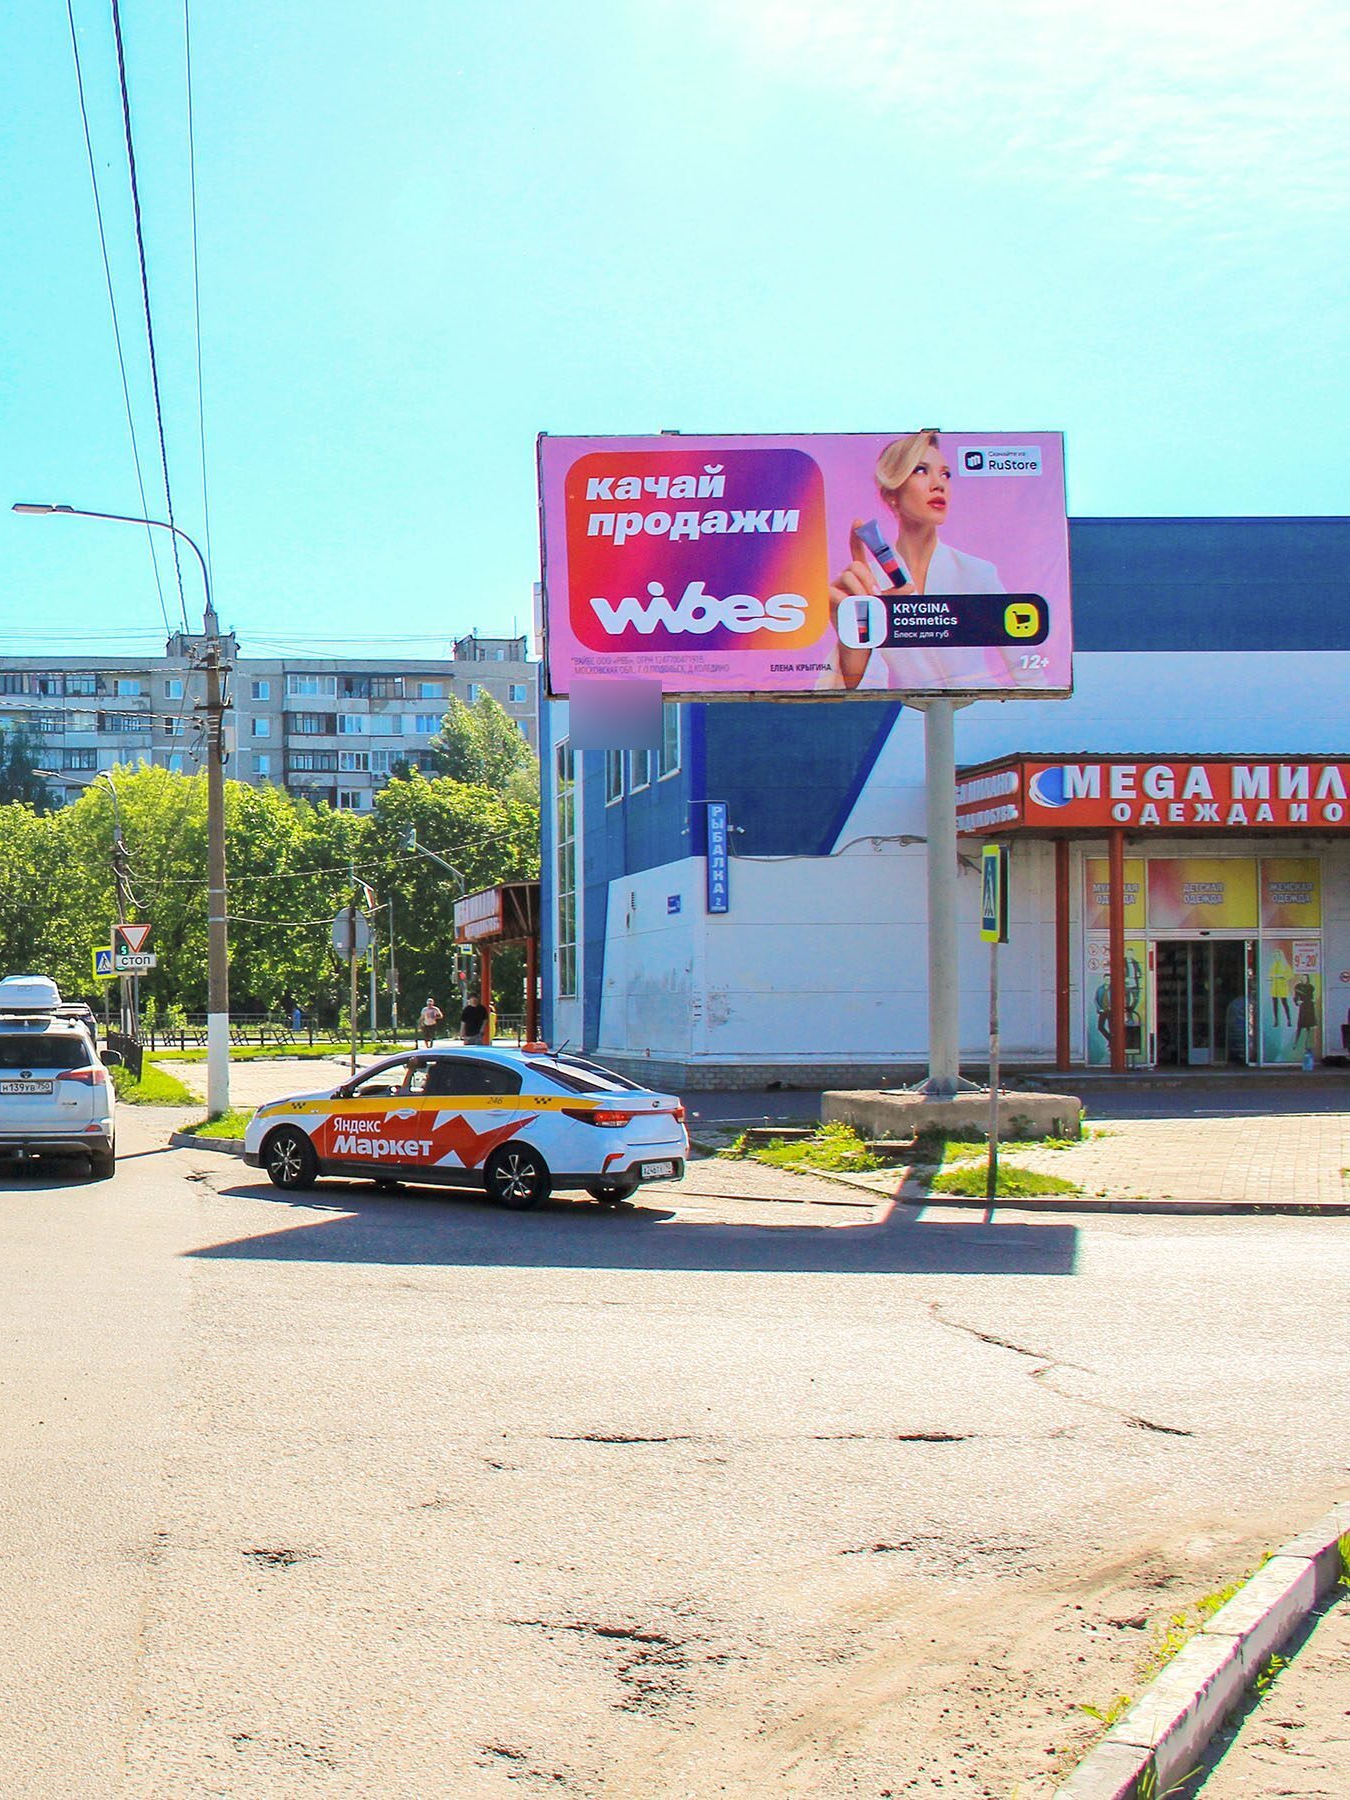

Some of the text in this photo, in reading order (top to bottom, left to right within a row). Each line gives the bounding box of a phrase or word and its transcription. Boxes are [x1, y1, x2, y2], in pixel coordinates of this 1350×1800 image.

[988, 460, 1038, 471] RuStore
[586, 464, 727, 501] качай
[587, 509, 801, 546] продажи
[589, 581, 809, 635] wibes
[893, 603, 950, 615] KRYGINA
[893, 615, 958, 626] cosmetics
[894, 630, 950, 640] Блеск для губ
[770, 663, 832, 672] ЕЛЕНА КРЫГИНА
[1020, 654, 1050, 669] 12+
[1063, 766, 1348, 799] MEGA МИЛ
[1111, 802, 1344, 826] ОДЕЖДА И О
[711, 806, 725, 894] РЫБАЛКА
[1184, 882, 1225, 893] ДЕТСКАЯ
[1183, 894, 1224, 905] ОДЕЖДА
[1272, 893, 1311, 904] ОДЕЖДА
[121, 957, 151, 966] СТОП
[2, 1083, 36, 1092] Н139УВ
[333, 1117, 381, 1135] Яндекс
[332, 1135, 434, 1159] Маркет
